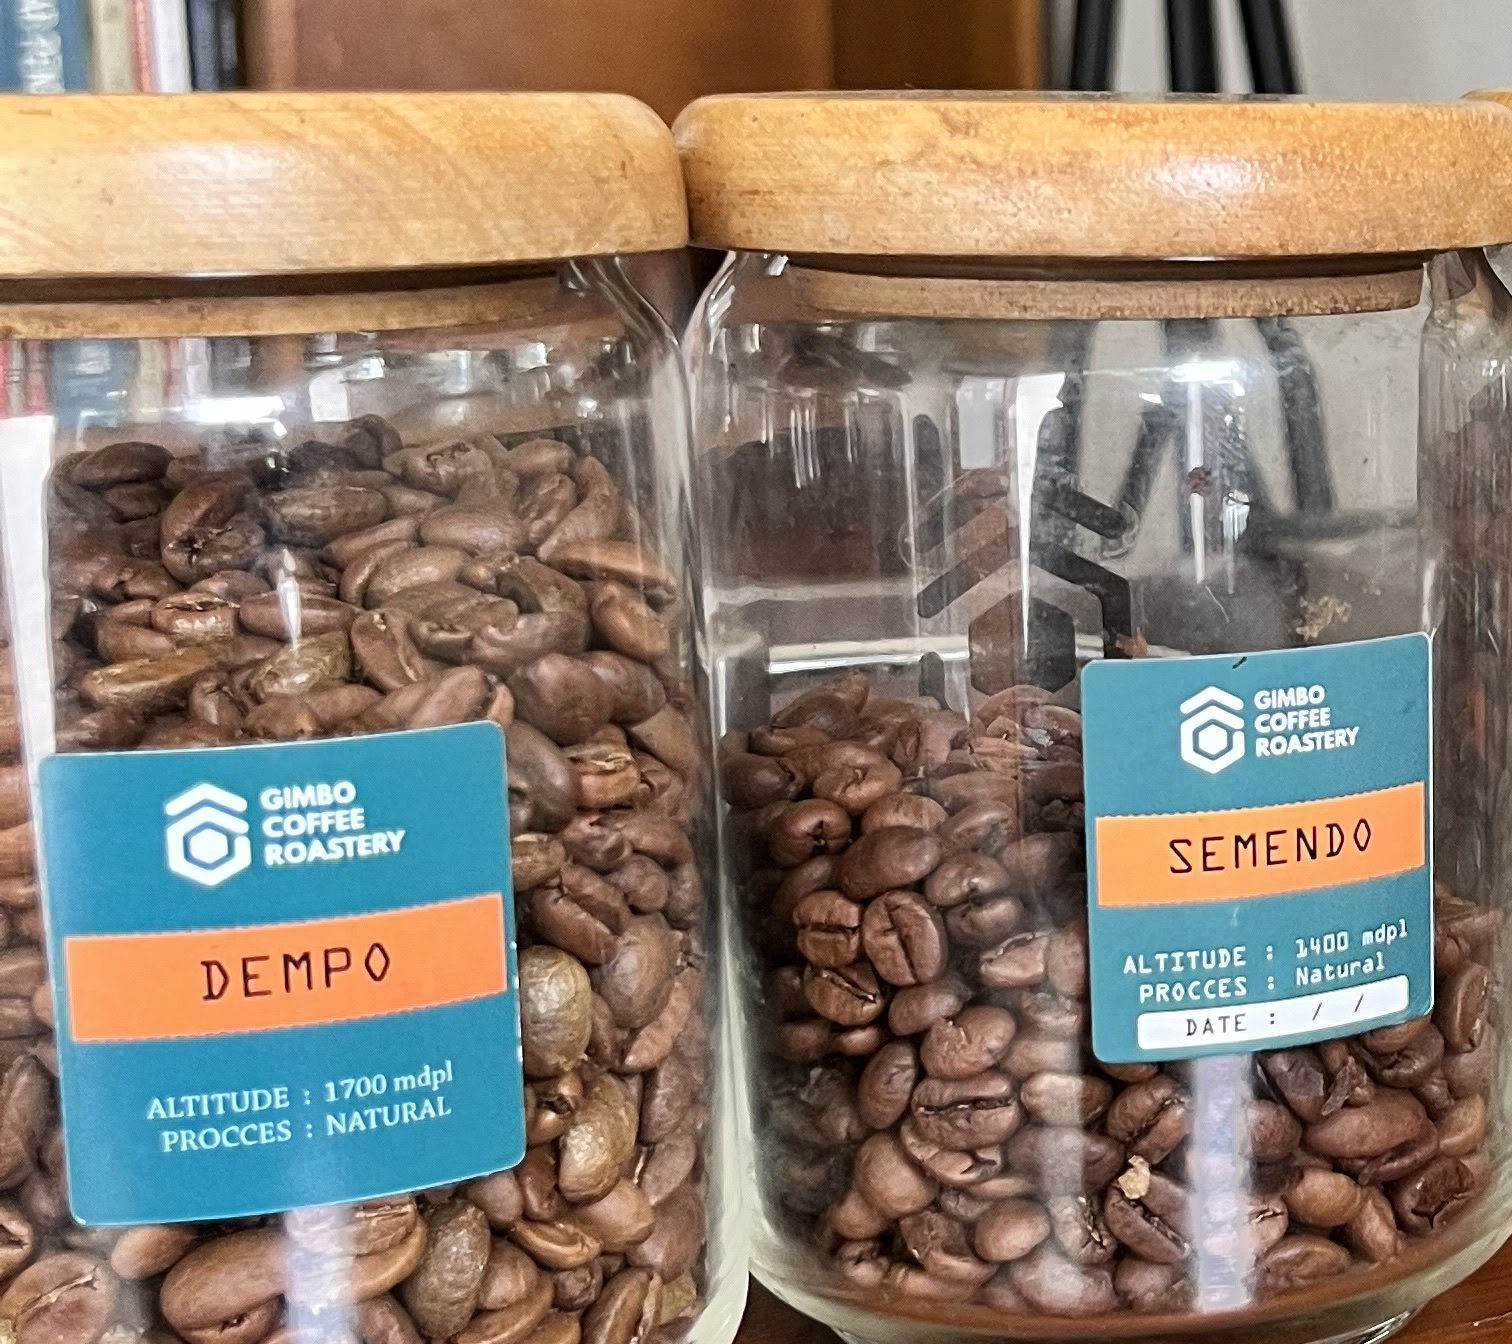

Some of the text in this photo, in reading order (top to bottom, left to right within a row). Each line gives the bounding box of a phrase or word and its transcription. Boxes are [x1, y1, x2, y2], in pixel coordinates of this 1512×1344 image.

[1254, 685, 1325, 710] GIMBO
[1255, 708, 1331, 733] COFFEE
[1256, 727, 1359, 757] ROASTERY
[260, 781, 356, 811] GIMBO
[262, 808, 364, 838] COFFEE
[264, 829, 406, 866] ROASTERY
[1169, 818, 1372, 874] SEMENDO
[1123, 946, 1247, 974] ALTITUDE
[1296, 931, 1349, 958] 1400
[1362, 919, 1407, 948] mdpl
[200, 942, 391, 1001] DEMPO
[1140, 976, 1247, 1003] PROCCES
[1296, 954, 1385, 985] Natural
[1186, 1014, 1247, 1036] DATE
[147, 1085, 290, 1120] ALTITUDE
[324, 1074, 387, 1103] 1700
[394, 1060, 453, 1095] mdpl
[162, 1119, 292, 1152] PROCCES
[326, 1096, 451, 1136] NATURAL
